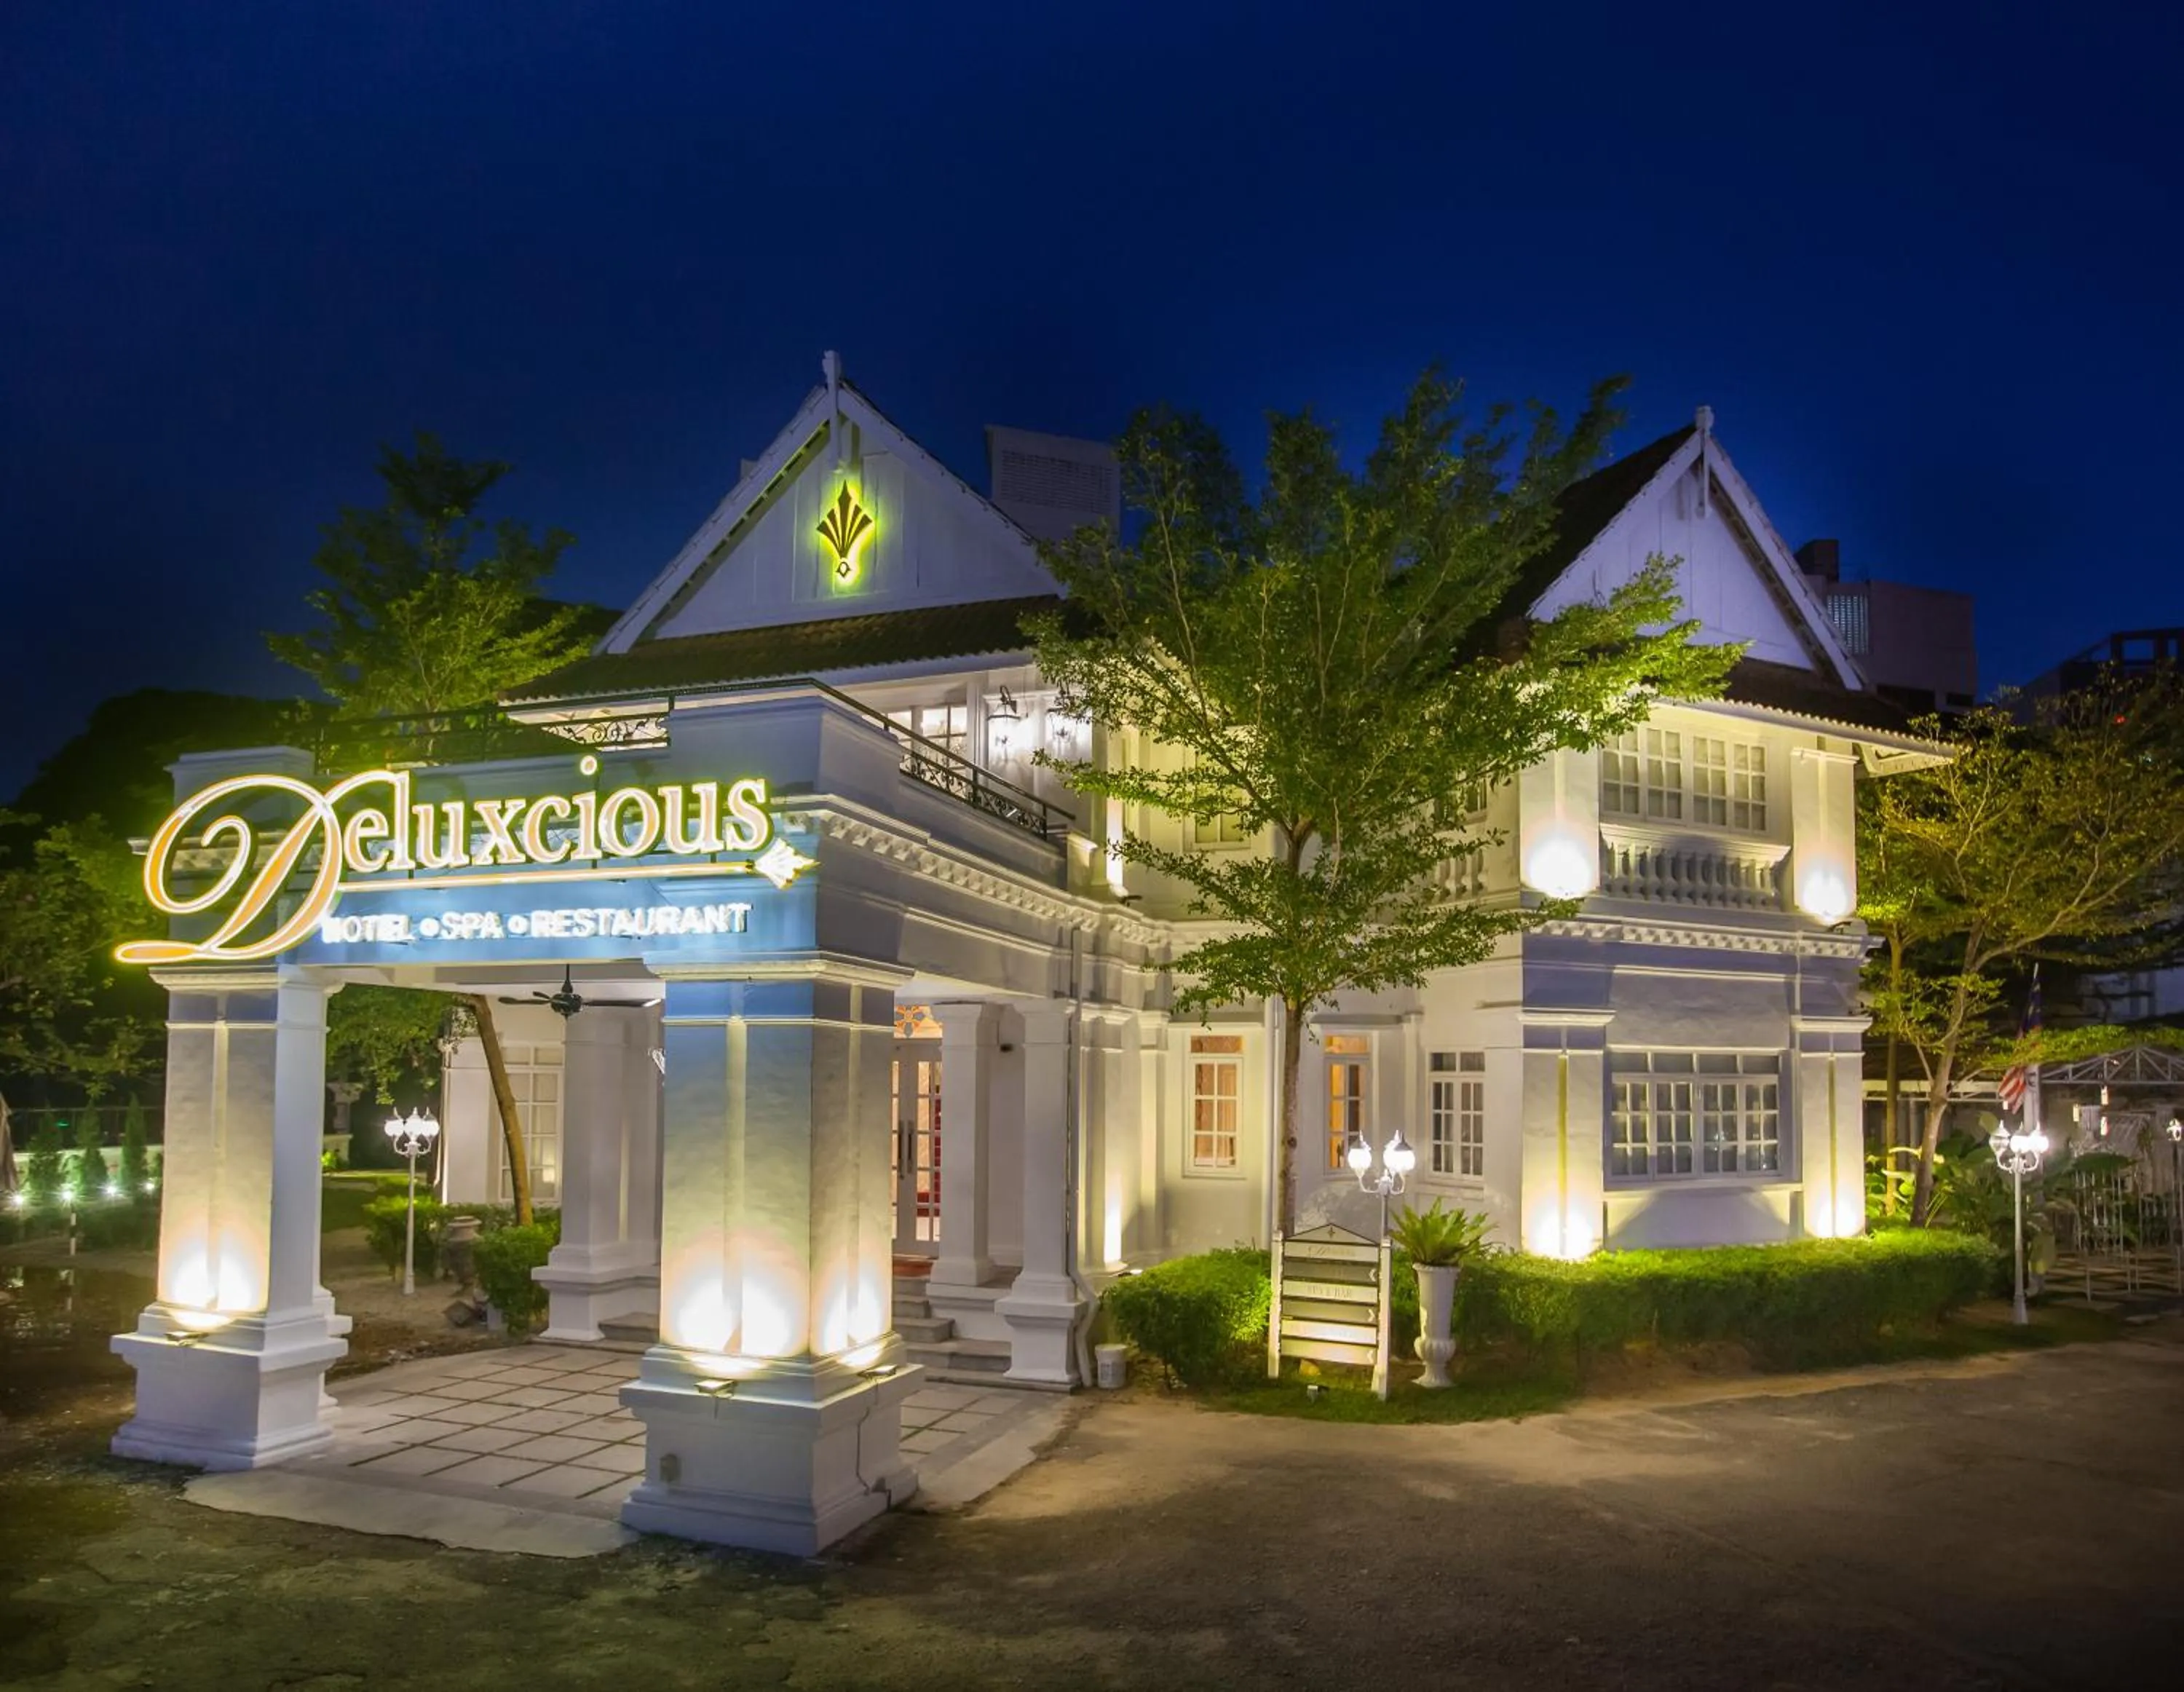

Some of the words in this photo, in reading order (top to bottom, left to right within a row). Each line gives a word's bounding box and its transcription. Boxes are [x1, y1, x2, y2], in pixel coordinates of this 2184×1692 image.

[114, 755, 772, 962] Deluxcious
[321, 912, 414, 944] HOTEL
[441, 911, 504, 939] SPA
[531, 902, 753, 937] RESTAURANT
